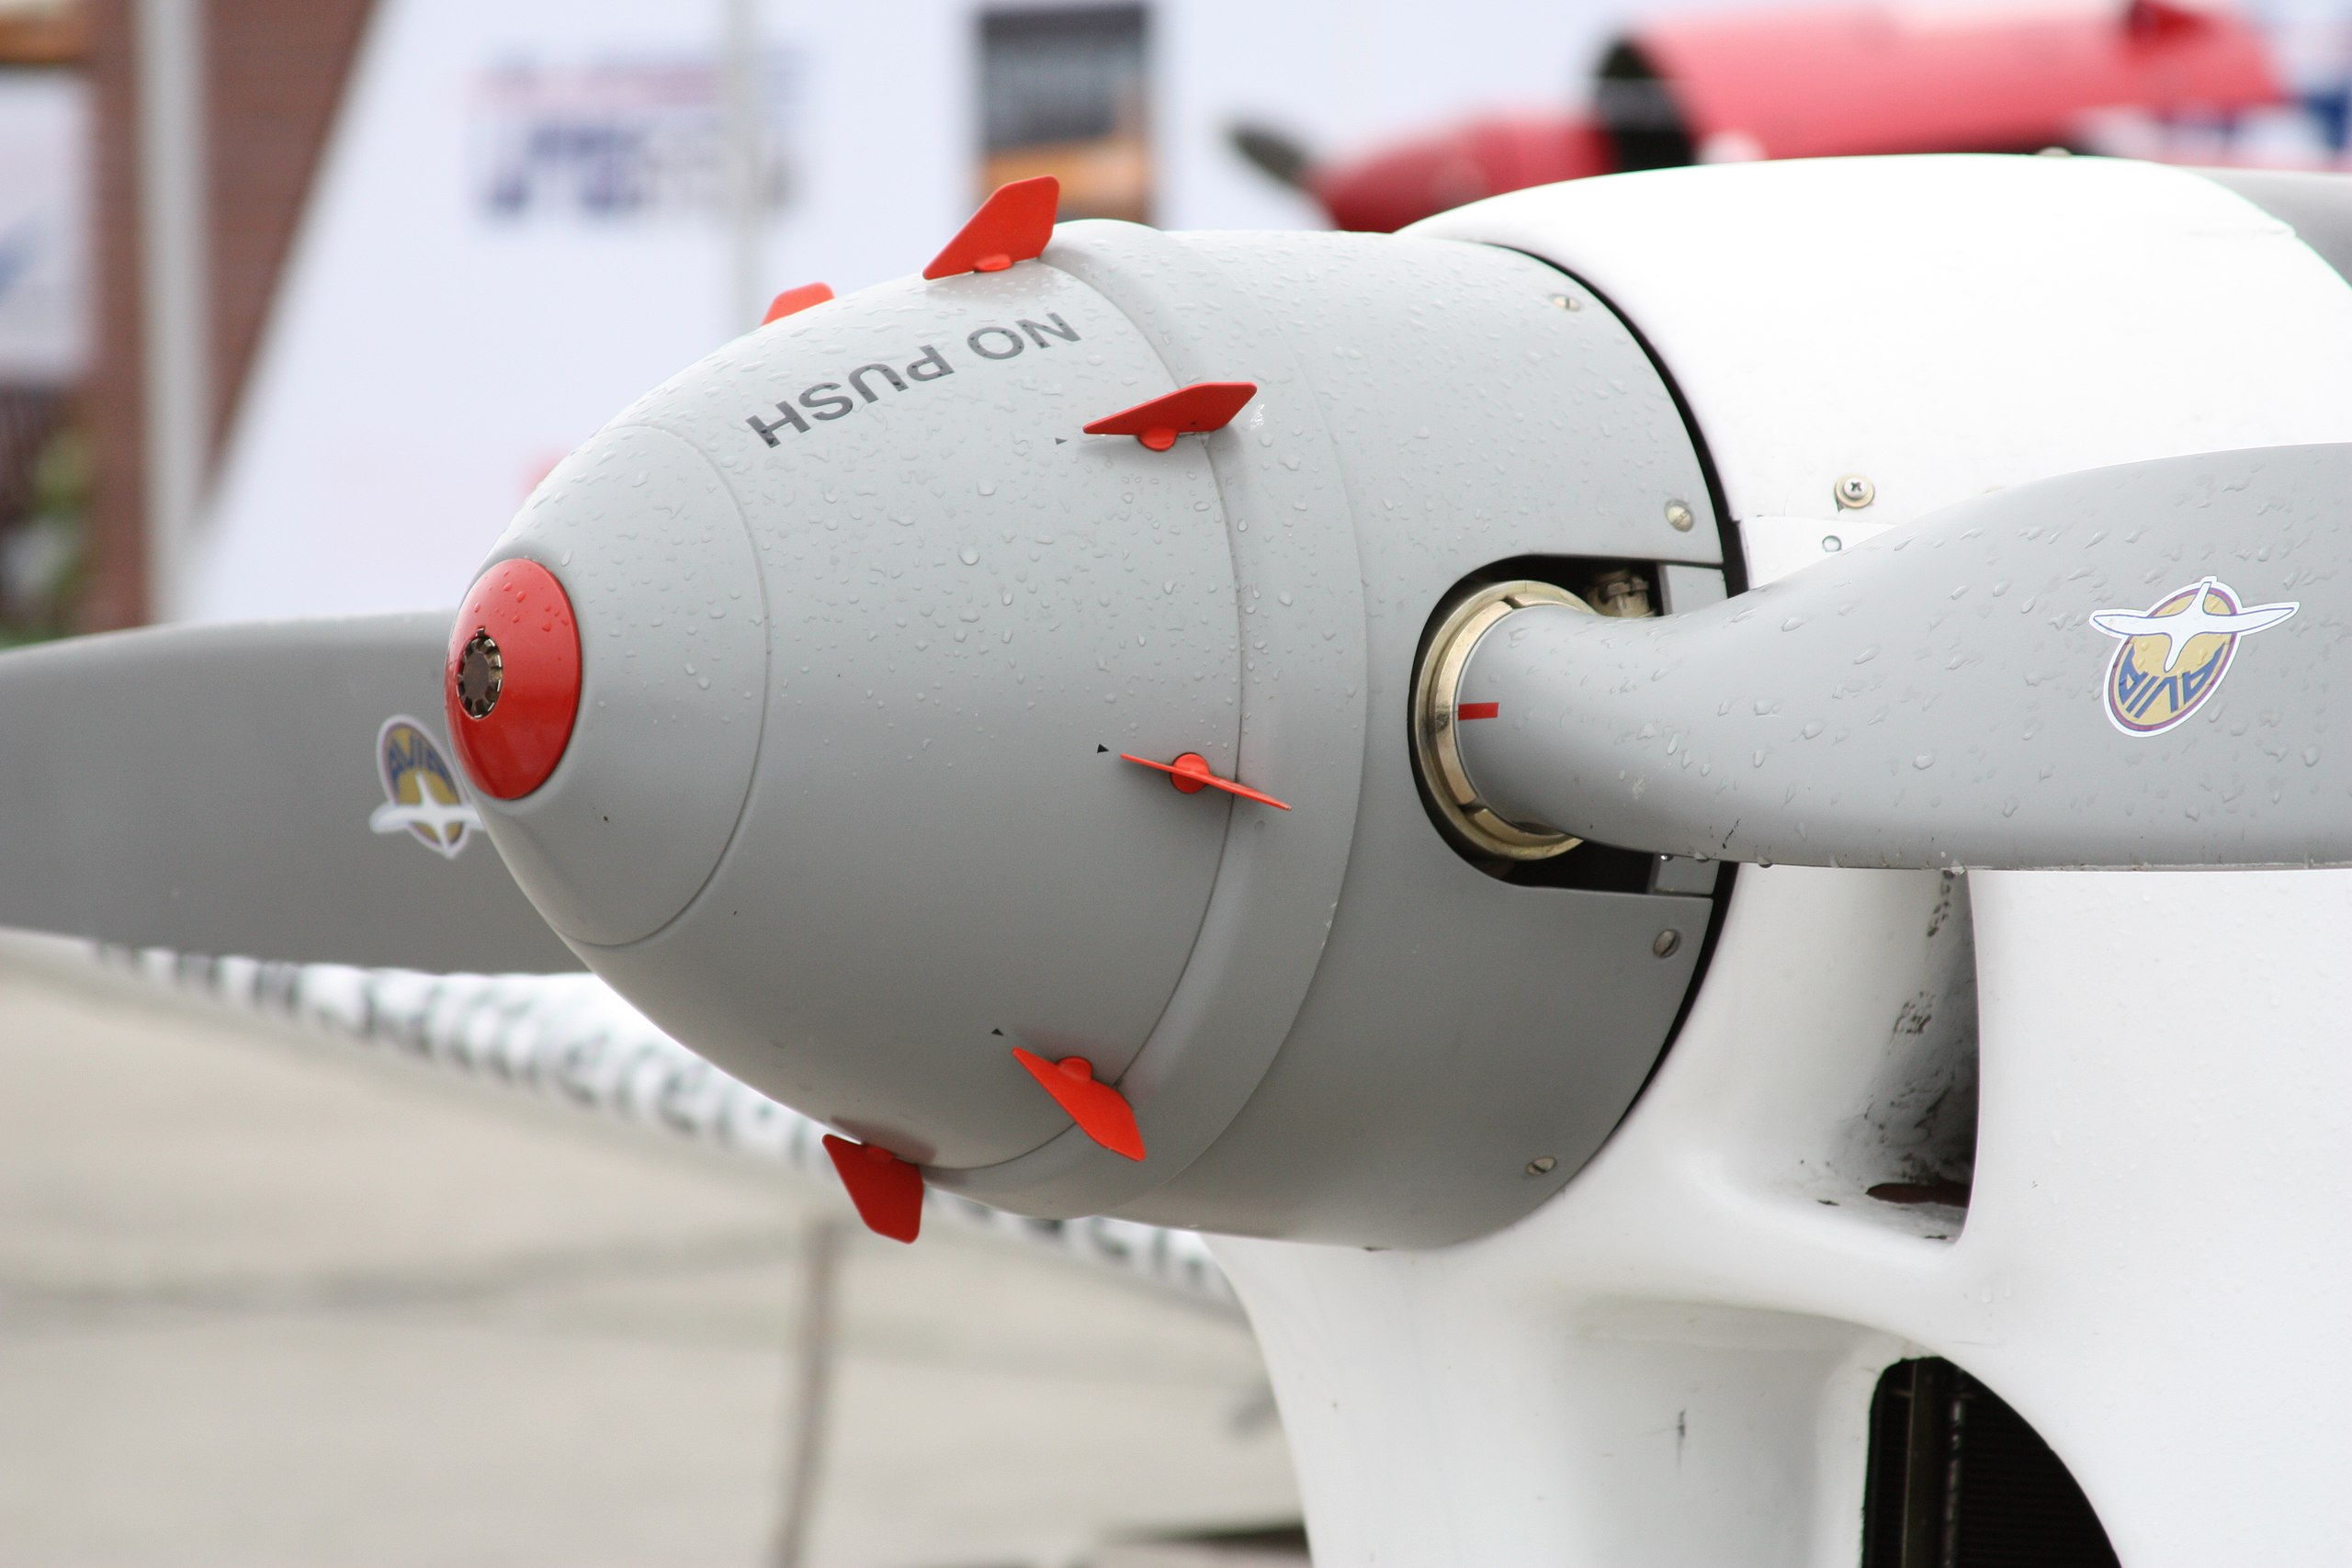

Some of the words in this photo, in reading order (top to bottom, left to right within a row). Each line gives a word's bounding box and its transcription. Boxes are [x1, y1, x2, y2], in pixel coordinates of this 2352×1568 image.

[967, 312, 1081, 360] NO
[745, 344, 955, 449] PUSH
[2118, 640, 2226, 719] AVIA
[387, 734, 457, 795] AVIA
